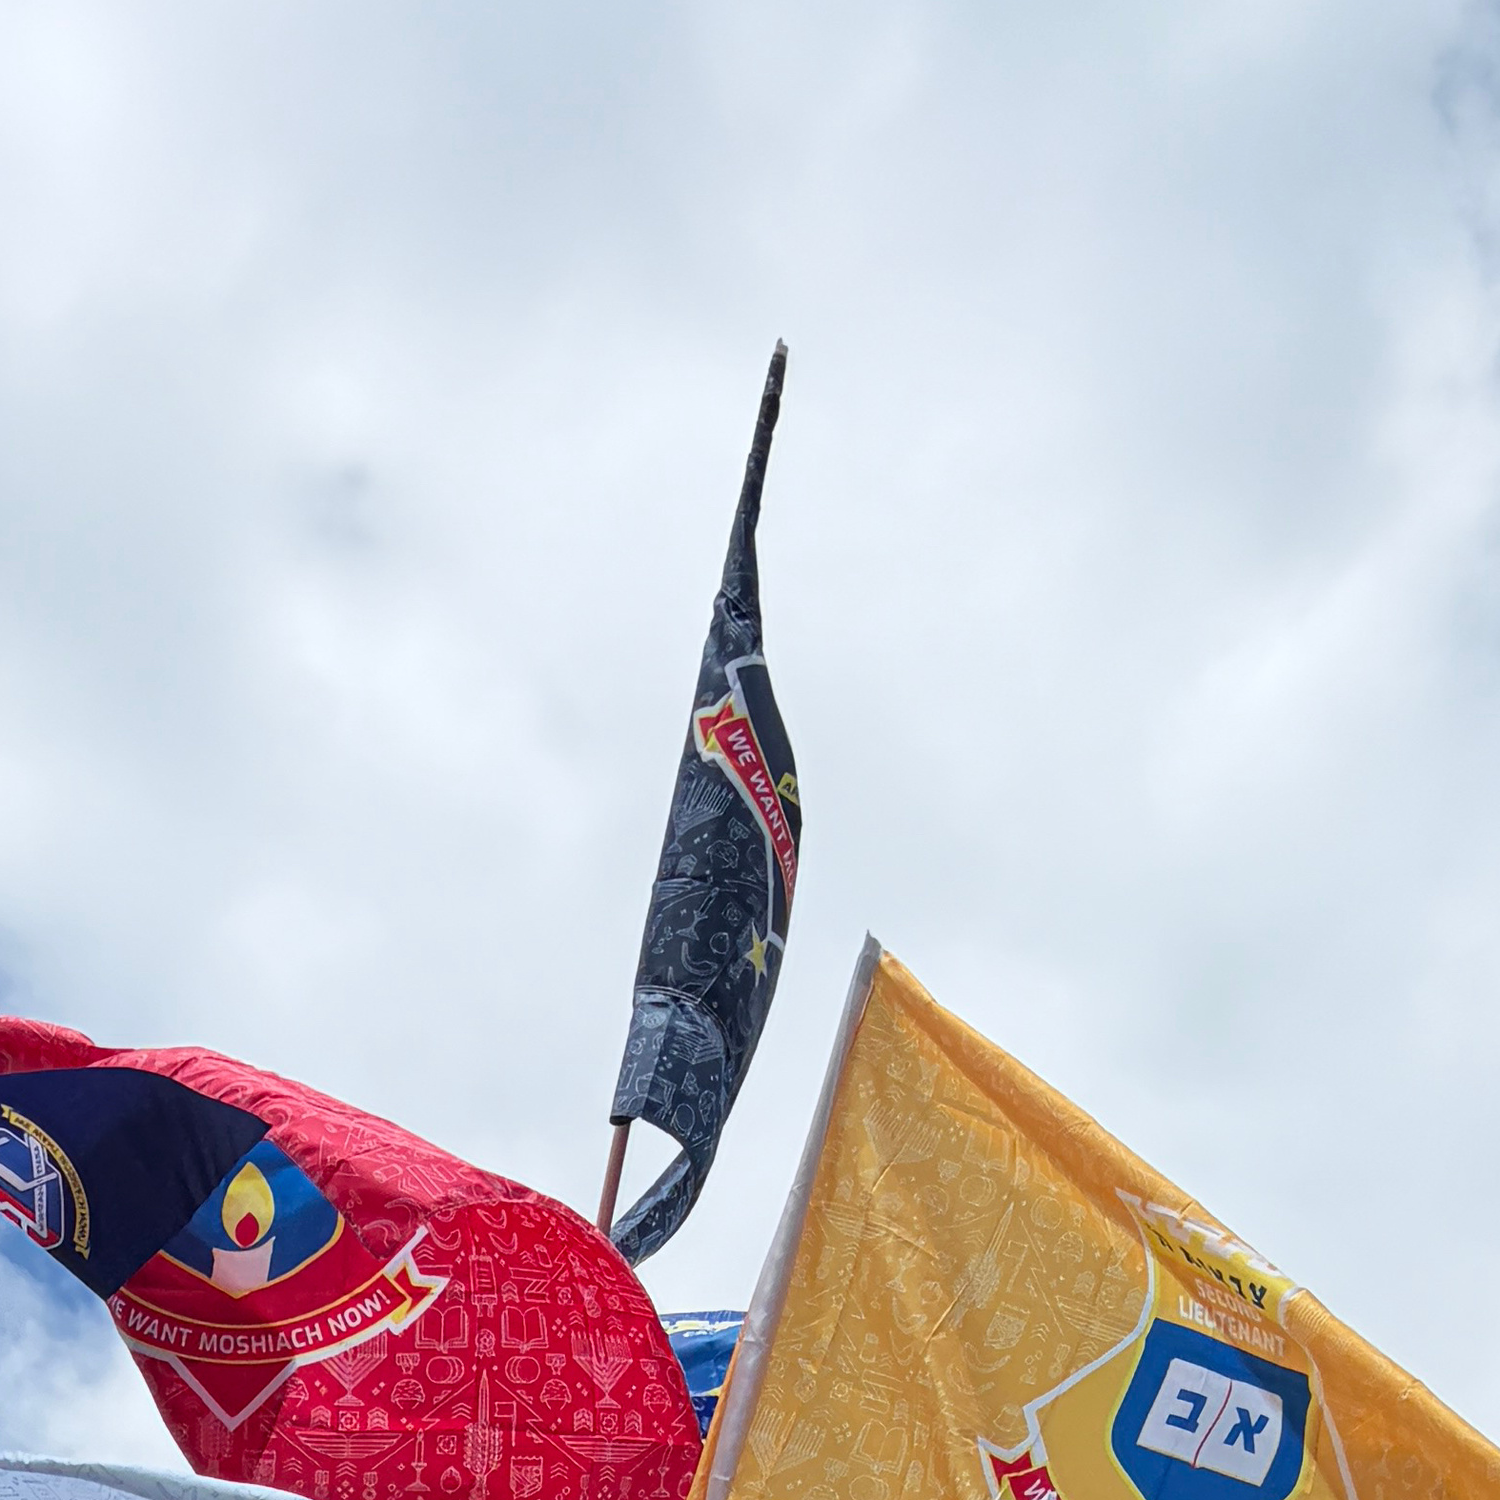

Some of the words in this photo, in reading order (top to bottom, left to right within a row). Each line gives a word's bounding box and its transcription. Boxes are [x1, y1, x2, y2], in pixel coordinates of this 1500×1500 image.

[728, 728, 756, 767] WE
[750, 769, 787, 842] WANT
[128, 1307, 193, 1347] WANT
[199, 1325, 324, 1355] MOSHIACH
[327, 1289, 392, 1337] NOW!
[1178, 1295, 1286, 1357] LIEUTENANT
